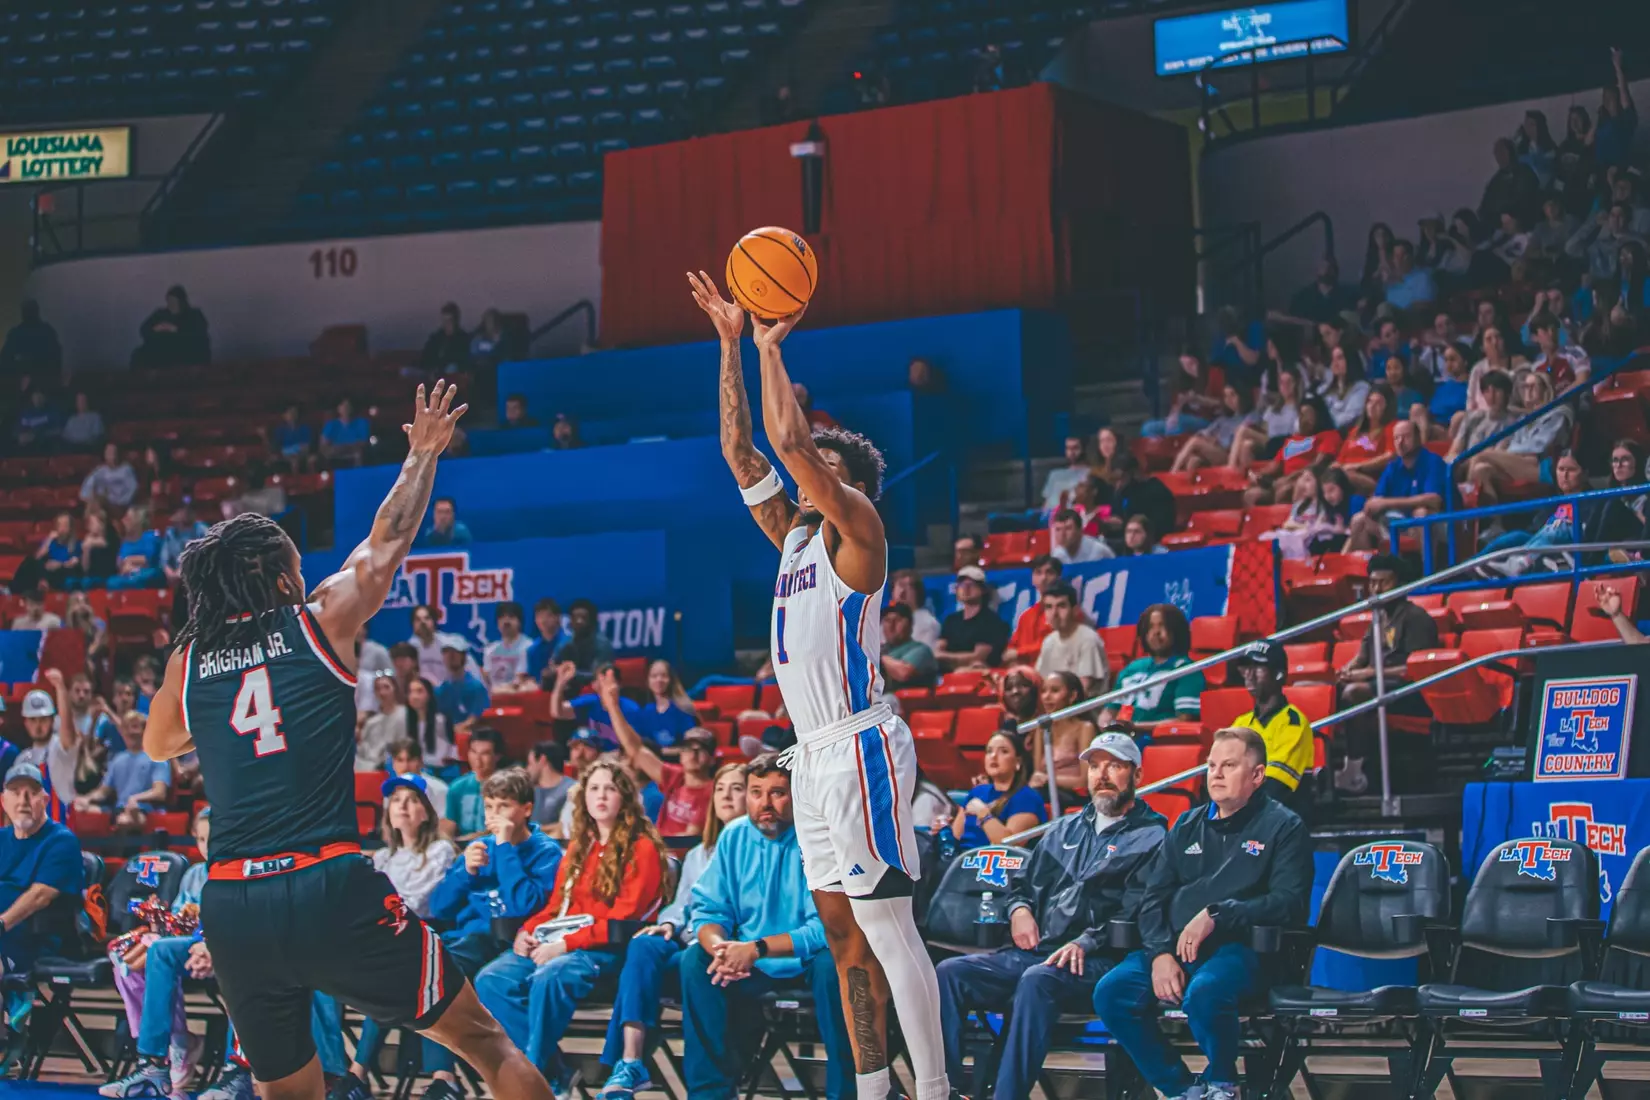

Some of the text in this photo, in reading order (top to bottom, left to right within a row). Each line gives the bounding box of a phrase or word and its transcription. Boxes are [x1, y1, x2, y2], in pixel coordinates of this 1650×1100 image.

[7, 134, 103, 157] LOUISIANA
[21, 156, 103, 178] LOTTERY
[308, 248, 359, 280] 110
[776, 606, 789, 665] 1
[199, 632, 293, 679] BRIGHAM JR.
[229, 664, 288, 758] 4
[1552, 688, 1620, 709] BULLDOG
[1544, 752, 1616, 773] COUNTRY
